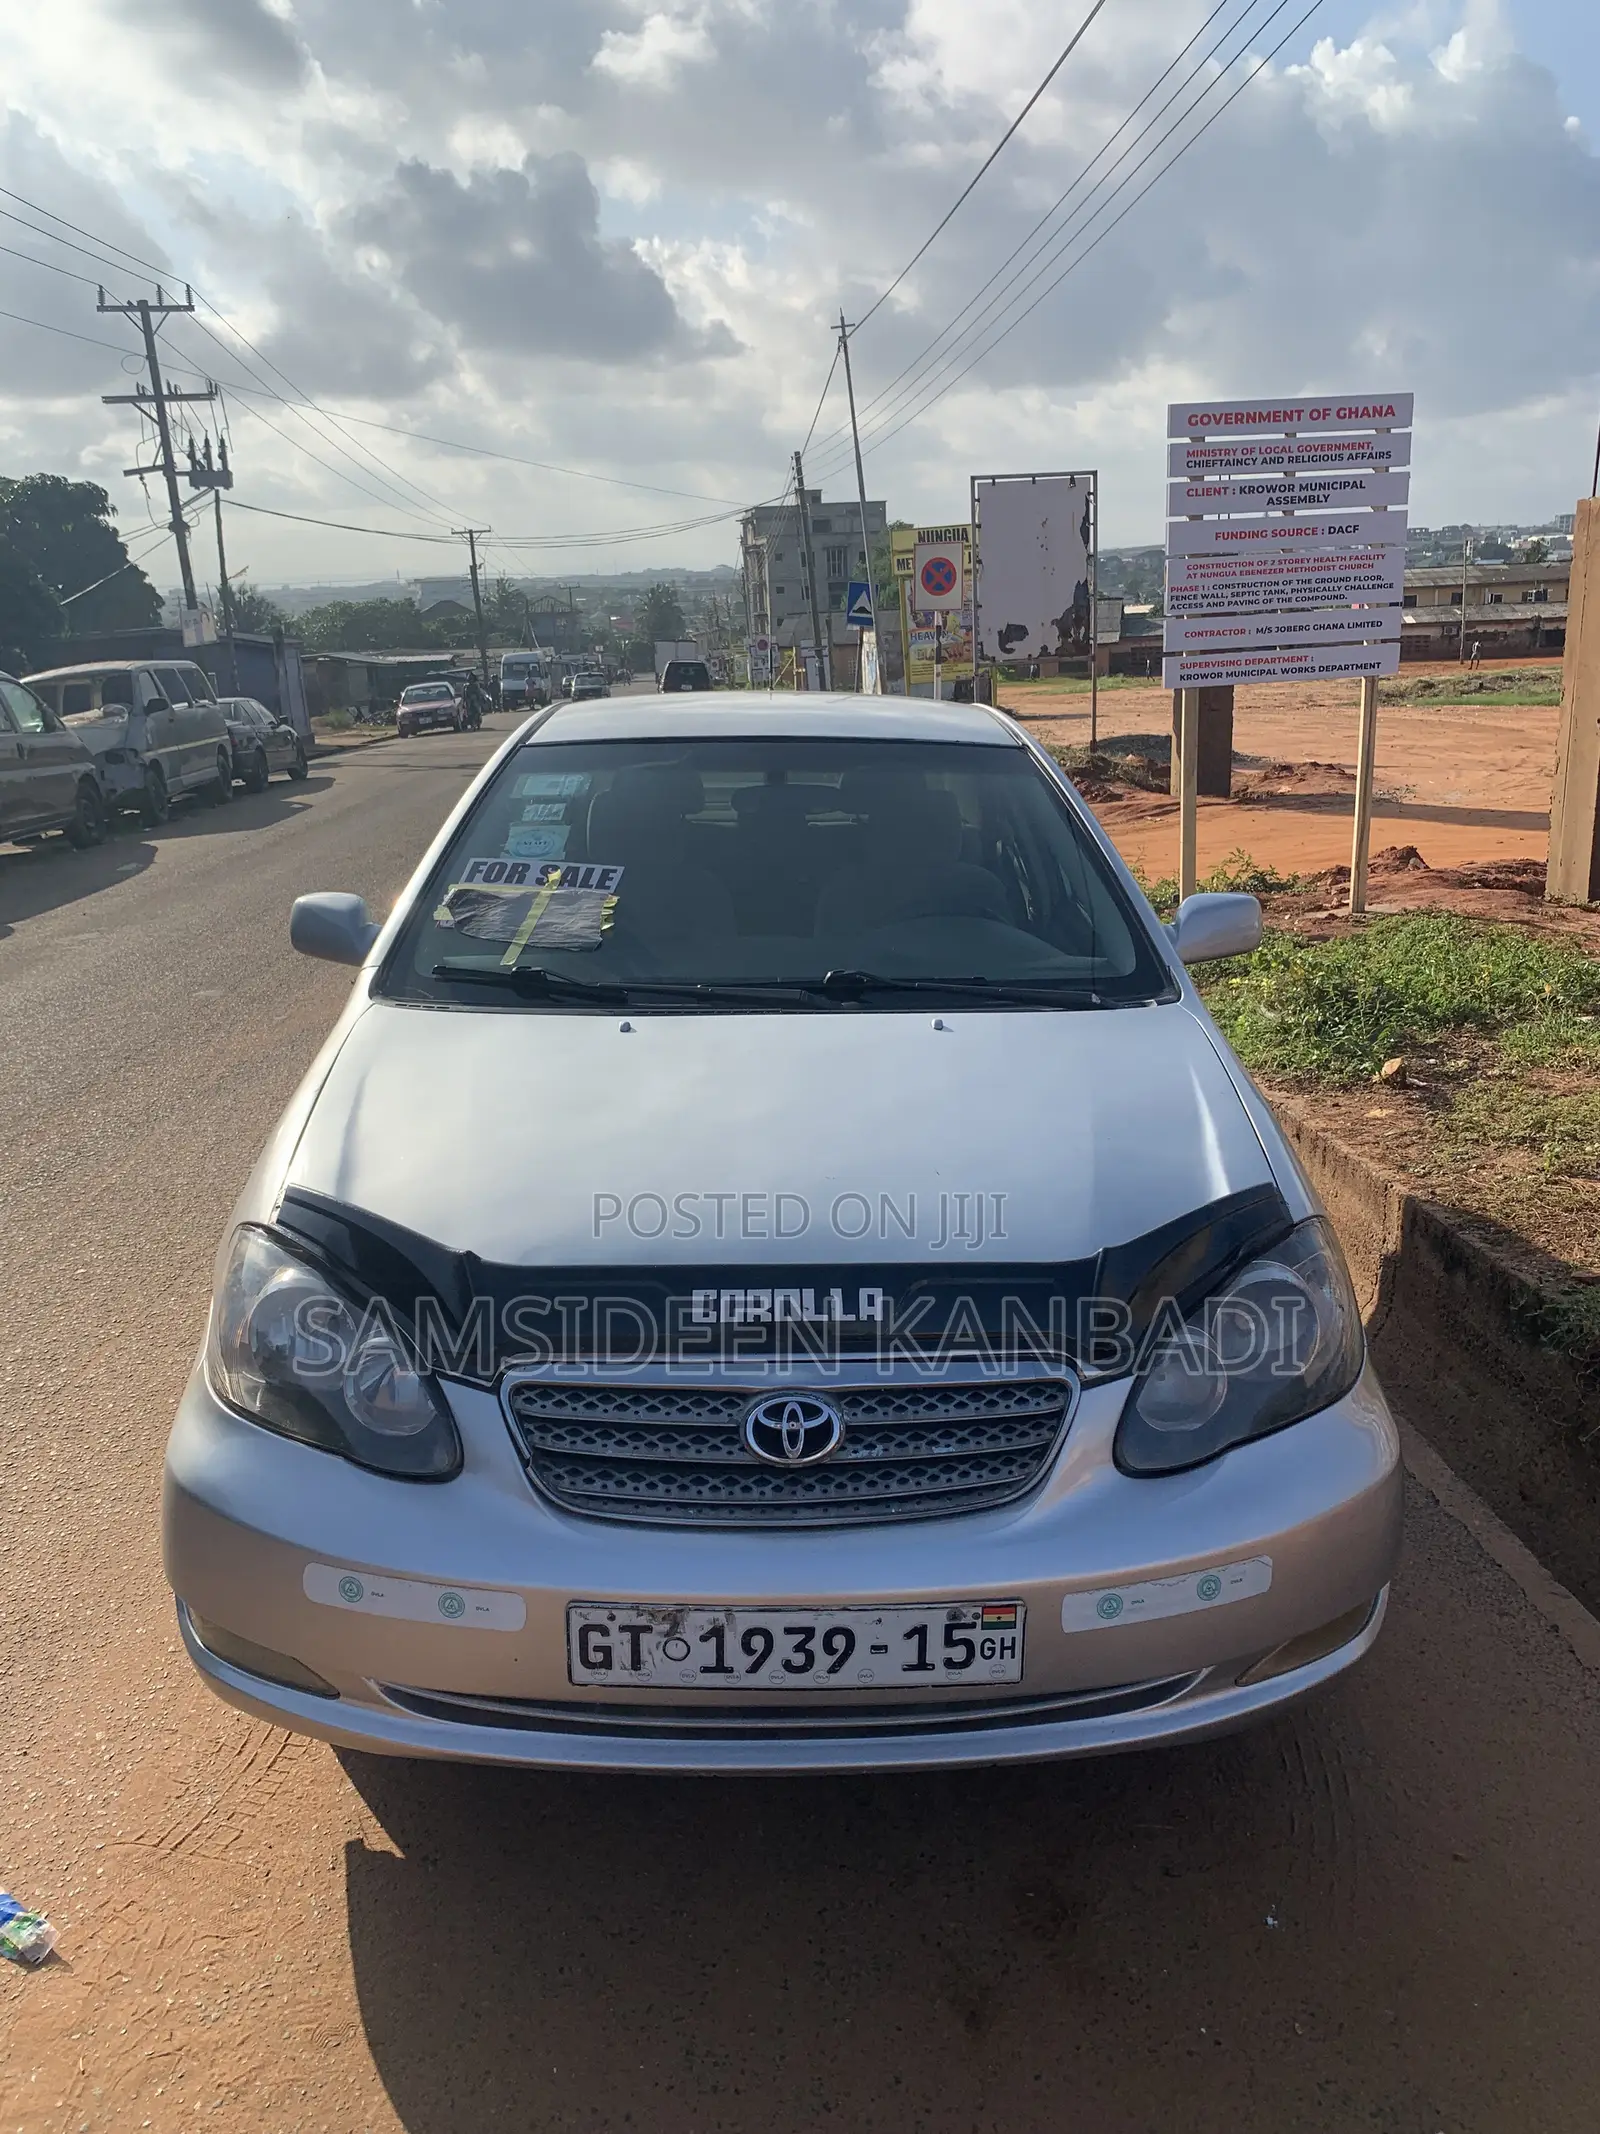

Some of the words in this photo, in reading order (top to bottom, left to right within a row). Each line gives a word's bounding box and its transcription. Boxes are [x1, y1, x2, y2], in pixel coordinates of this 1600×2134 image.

[1188, 409, 1304, 427] GOVERNMENT
[1309, 408, 1331, 421] OF
[1336, 404, 1396, 420] GHANA
[1186, 447, 1238, 458] MINISTRY
[1241, 446, 1256, 456] OF
[1259, 445, 1294, 455] LOCAL
[1297, 441, 1374, 453] GOVERNMENT,
[1186, 457, 1258, 468] CHIEFTAINCY
[1260, 456, 1284, 465] AND
[1288, 453, 1344, 464] RELIGIOUS
[1347, 450, 1392, 461] AFFAIRS
[1186, 486, 1229, 497] CLIENT
[1239, 484, 1295, 495] KROWOR
[1299, 480, 1366, 492] MUNICIPAL
[1266, 494, 1331, 506] ASSEMBLY
[1215, 529, 1268, 541] FUNDING
[1271, 527, 1318, 538] SOURCE
[1328, 524, 1360, 535] DACF
[1186, 560, 1254, 571] CONSTRUCTION
[1256, 559, 1269, 567] OF
[1278, 557, 1311, 566] STOREY
[1313, 555, 1347, 564] HEALTH
[1349, 553, 1386, 562] FACILITY
[1200, 570, 1237, 579] NUNGUA
[1240, 567, 1284, 577] EBENEZER
[1286, 564, 1336, 574] METHODIST
[1338, 562, 1374, 571] CHURCH
[1170, 585, 1199, 593] PHASE
[1212, 580, 1280, 591] CONSTRUCTION
[1314, 576, 1351, 584] GROUND
[1353, 574, 1385, 583] FLOOR,
[1170, 593, 1198, 602] FENCE
[1200, 592, 1228, 600] WALL,
[1230, 589, 1260, 598] SEPTIC
[1262, 587, 1289, 596] TANK,
[1290, 585, 1342, 595] PHYSICALLY
[1344, 582, 1394, 591] CHALLENGE
[1169, 602, 1204, 610] ACCESS
[1205, 601, 1225, 609] AND
[1227, 598, 1260, 607] PAVING
[1276, 596, 1293, 604] THE
[1295, 593, 1348, 603] COMPOUND.
[1184, 628, 1246, 639] CONTRACTOR
[1256, 626, 1272, 635] M/S
[1274, 624, 1311, 633] JOBERG
[1312, 622, 1345, 631] GHANA
[1347, 620, 1383, 629] LIMITED
[1179, 659, 1242, 670] SUPERVISING
[1244, 655, 1309, 666] DEPARTMENT
[1179, 671, 1223, 681] KROWOR
[1225, 668, 1278, 679] MUNICIPAL
[1280, 665, 1316, 675] WORKS
[1318, 662, 1382, 673] DEPARTMENT
[464, 861, 531, 884] FOR
[534, 864, 618, 891] SALE
[692, 1287, 884, 1323] COROLLA
[578, 1624, 653, 1671] GT
[979, 1636, 1016, 1660] GH
